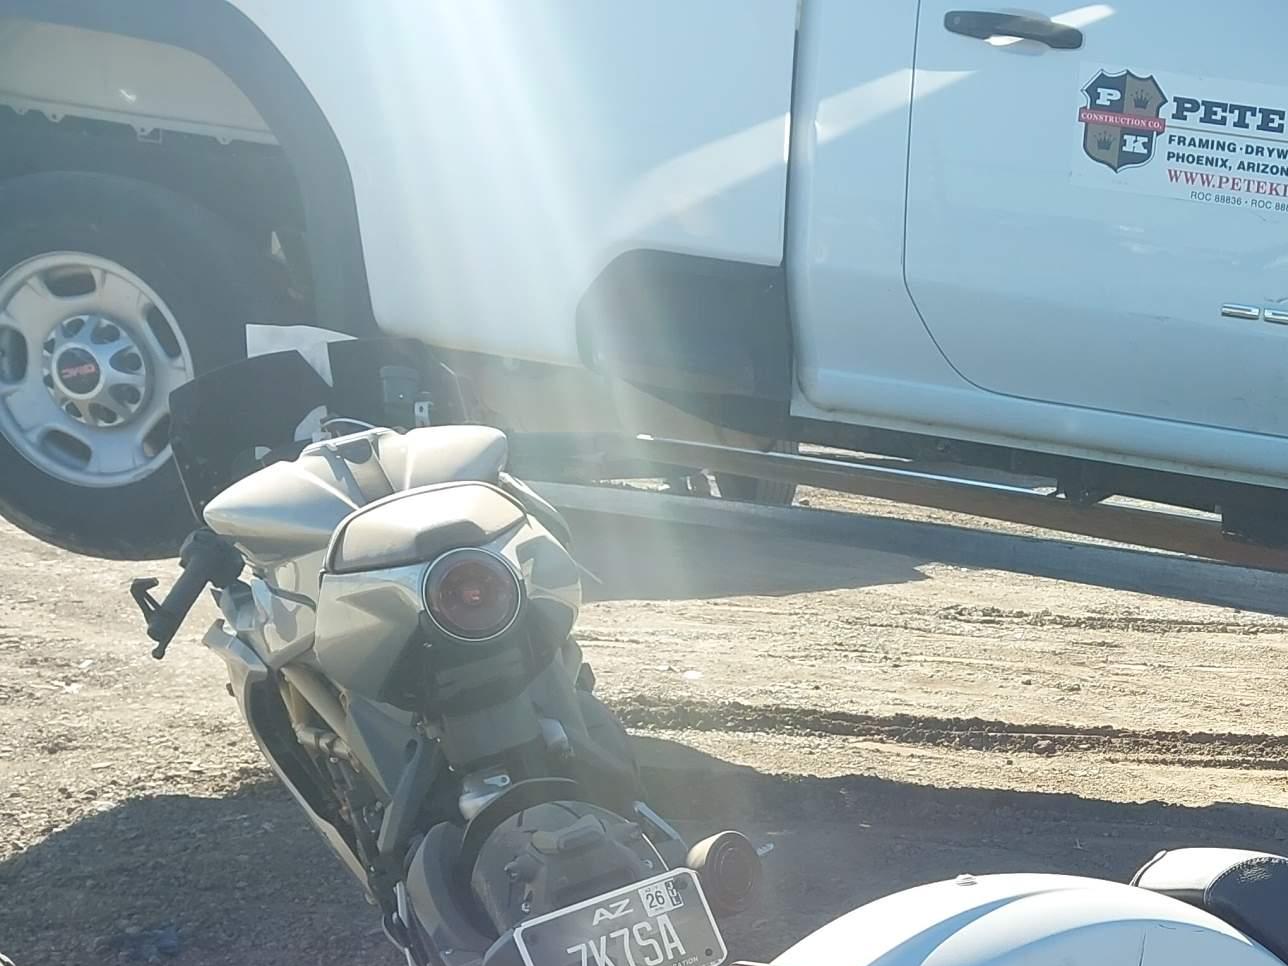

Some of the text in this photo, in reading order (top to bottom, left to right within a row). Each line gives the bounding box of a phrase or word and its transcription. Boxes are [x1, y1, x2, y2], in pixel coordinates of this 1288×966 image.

[1096, 87, 1121, 106] P
[1081, 111, 1147, 127] CONSTRUCTION
[1171, 96, 1286, 134] PETE
[1122, 134, 1148, 154] K
[1167, 151, 1232, 171] PHOENIX,
[1190, 191, 1212, 202] ROC
[1250, 199, 1272, 210] ROC
[646, 890, 665, 909] 26
[592, 898, 634, 926] AZ
